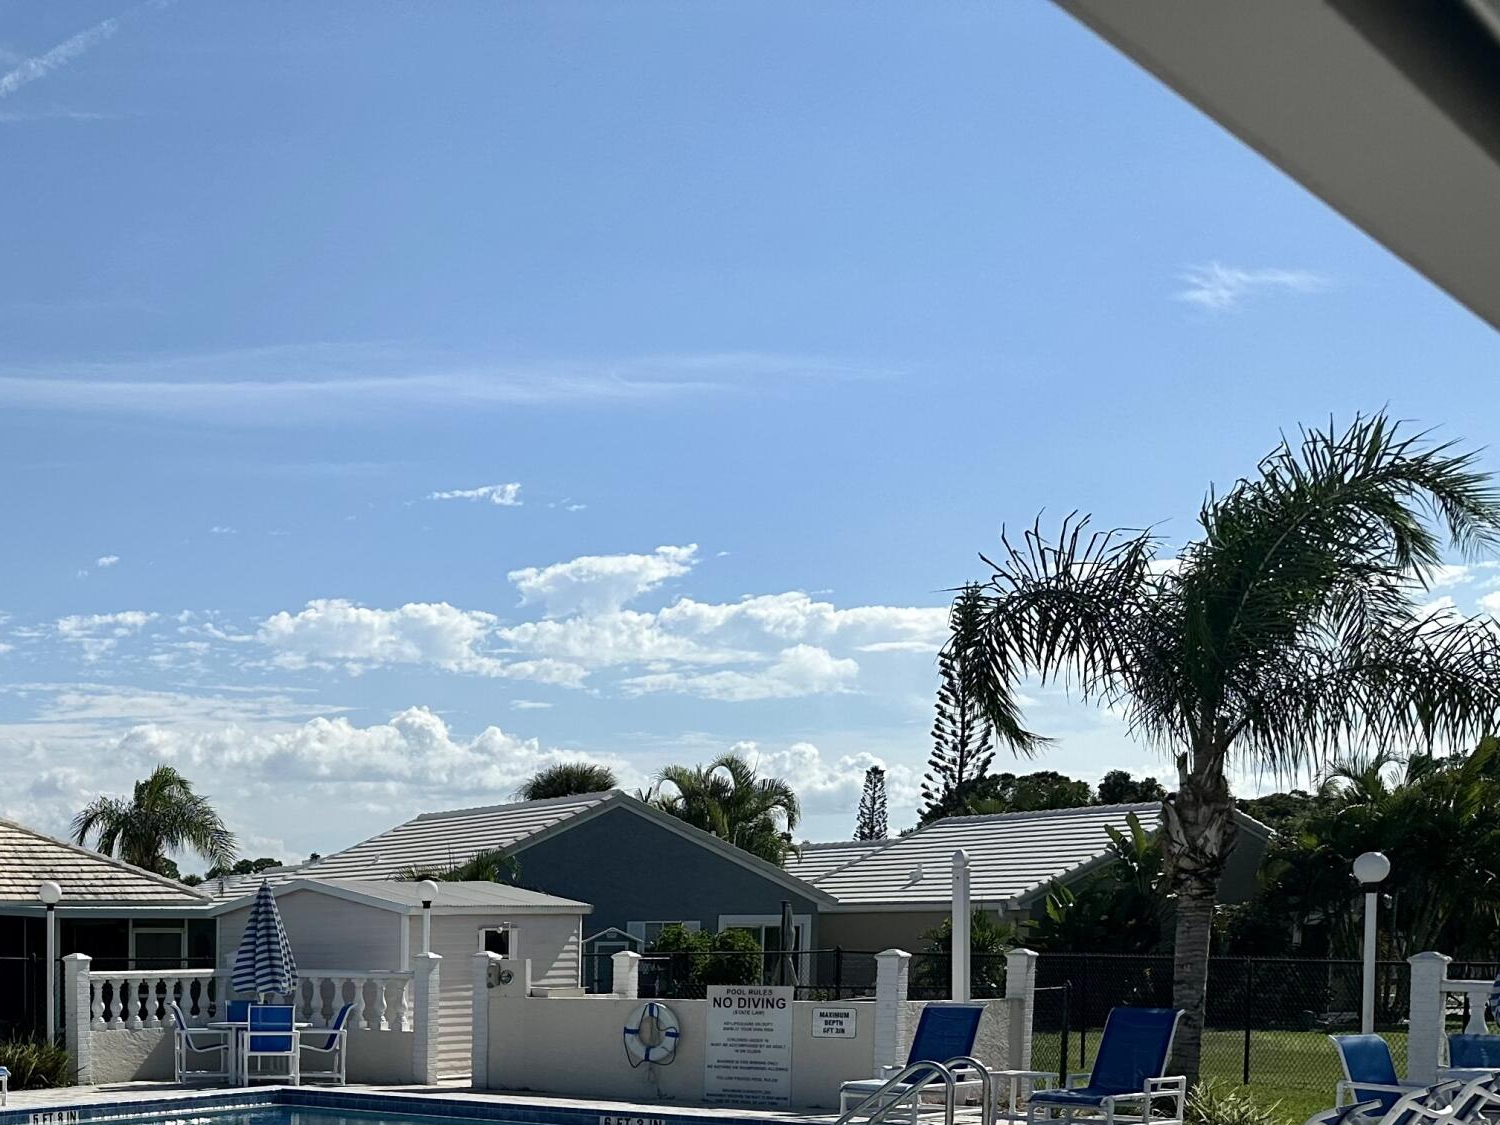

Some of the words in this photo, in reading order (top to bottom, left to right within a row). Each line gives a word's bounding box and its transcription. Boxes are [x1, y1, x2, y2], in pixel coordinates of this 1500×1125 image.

[749, 988, 773, 996] RULES
[713, 997, 733, 1008] NO
[737, 997, 787, 1009] DIVING
[42, 1112, 54, 1123] FT
[67, 1111, 76, 1121] IN
